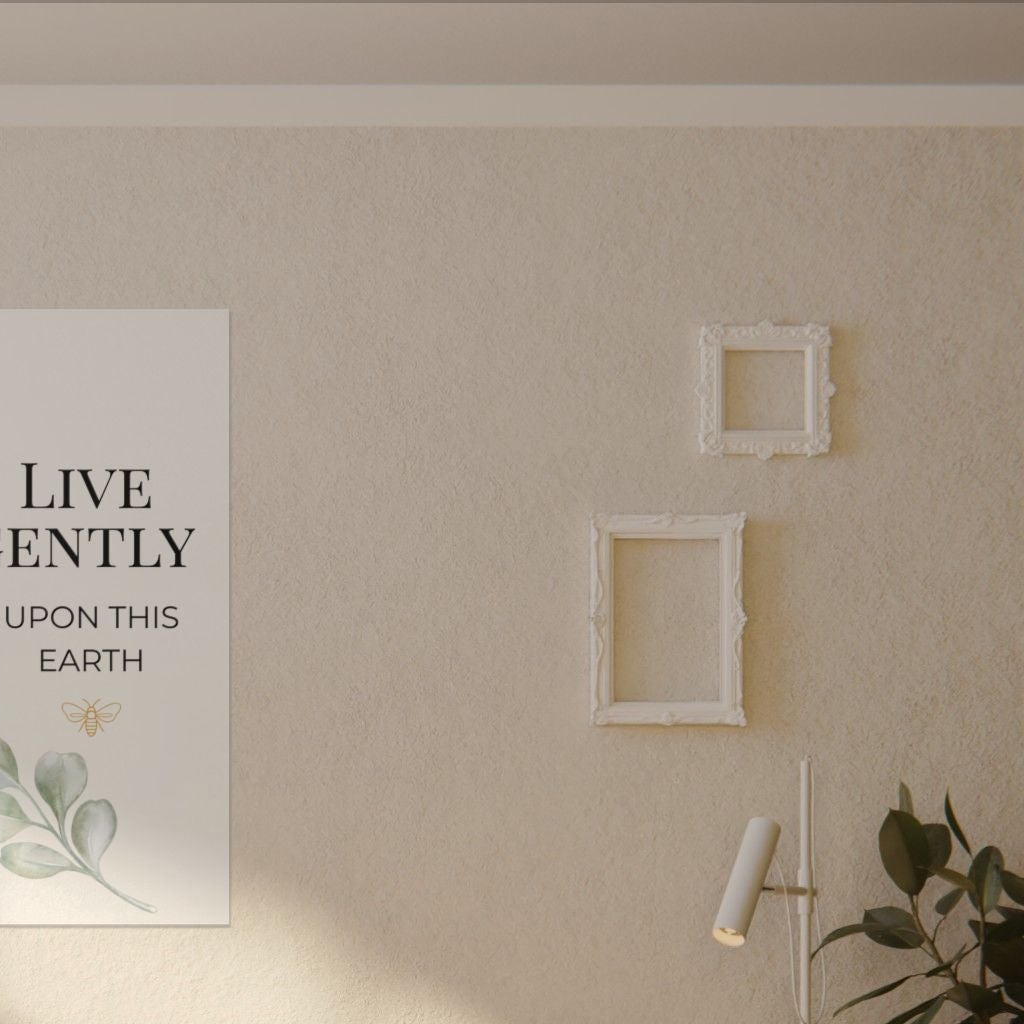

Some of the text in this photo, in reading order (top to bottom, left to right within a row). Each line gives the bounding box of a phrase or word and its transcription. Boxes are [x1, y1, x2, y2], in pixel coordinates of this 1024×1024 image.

[20, 462, 152, 509] LIVE
[5, 605, 179, 629] UPON THIS
[40, 648, 143, 673] EARTH
